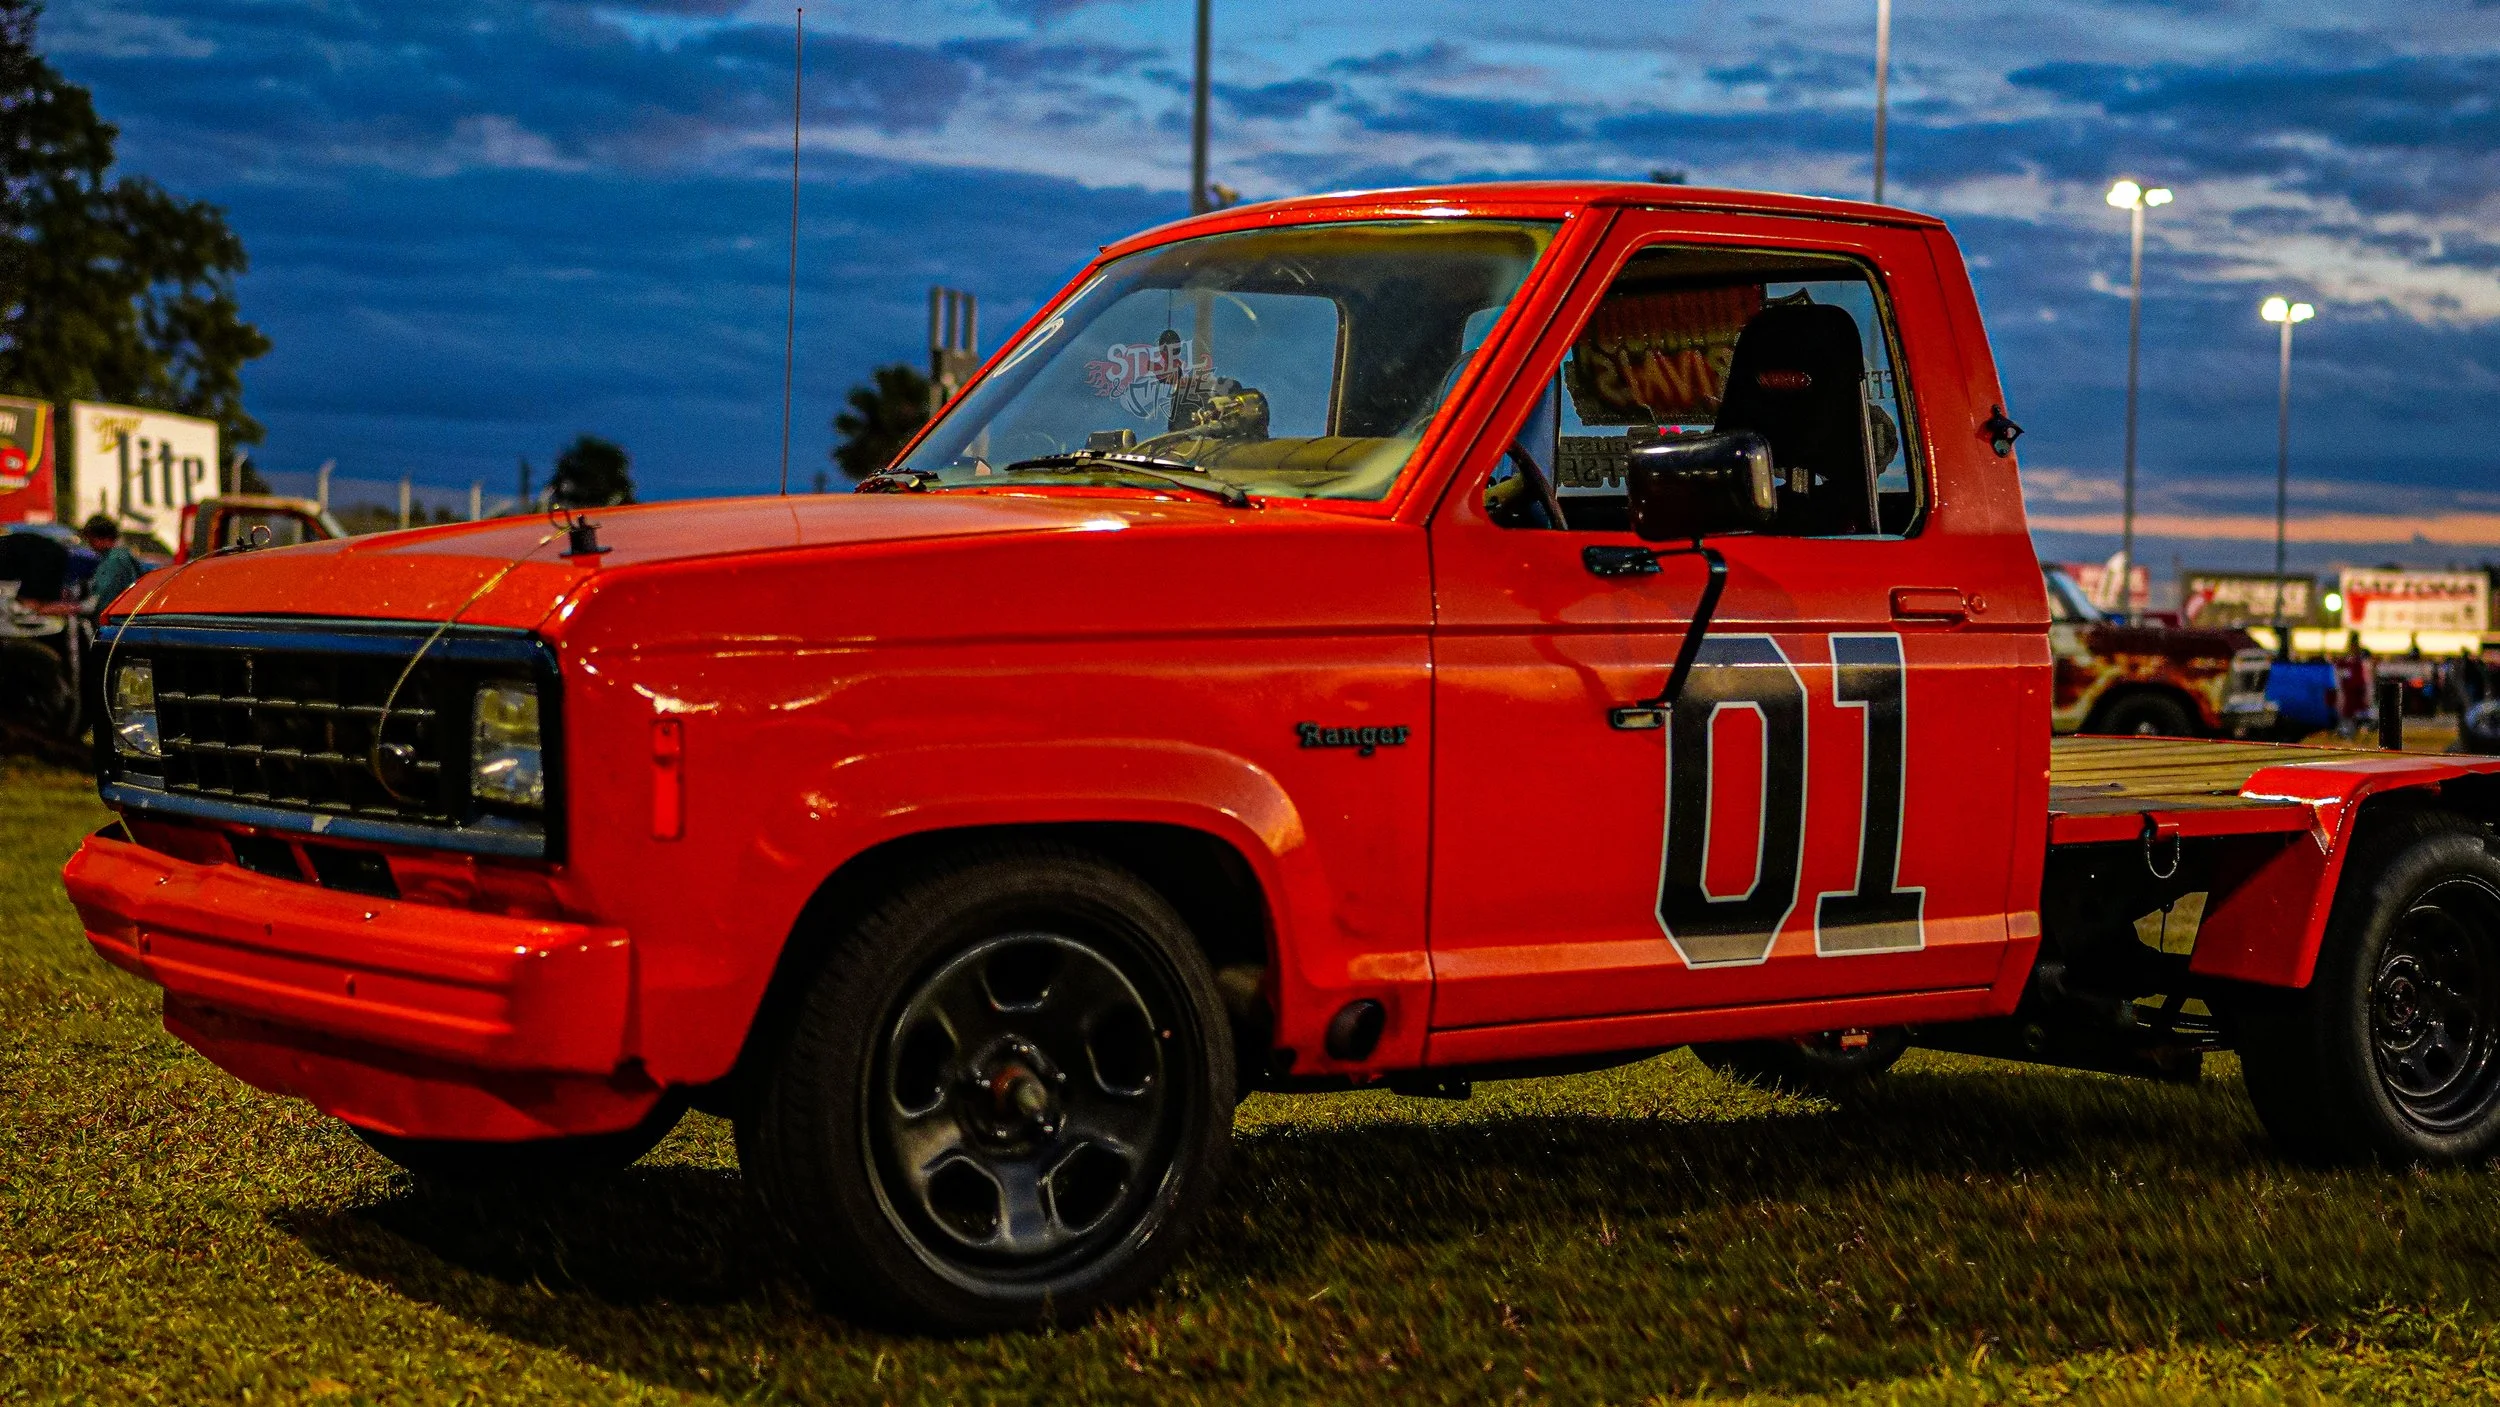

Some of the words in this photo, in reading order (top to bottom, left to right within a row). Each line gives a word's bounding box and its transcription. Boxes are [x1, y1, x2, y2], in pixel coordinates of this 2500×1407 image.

[1106, 339, 1208, 382] STEEL
[1109, 378, 1128, 401] &
[1297, 721, 1412, 757] Ranger
[1655, 632, 1926, 970] 01
